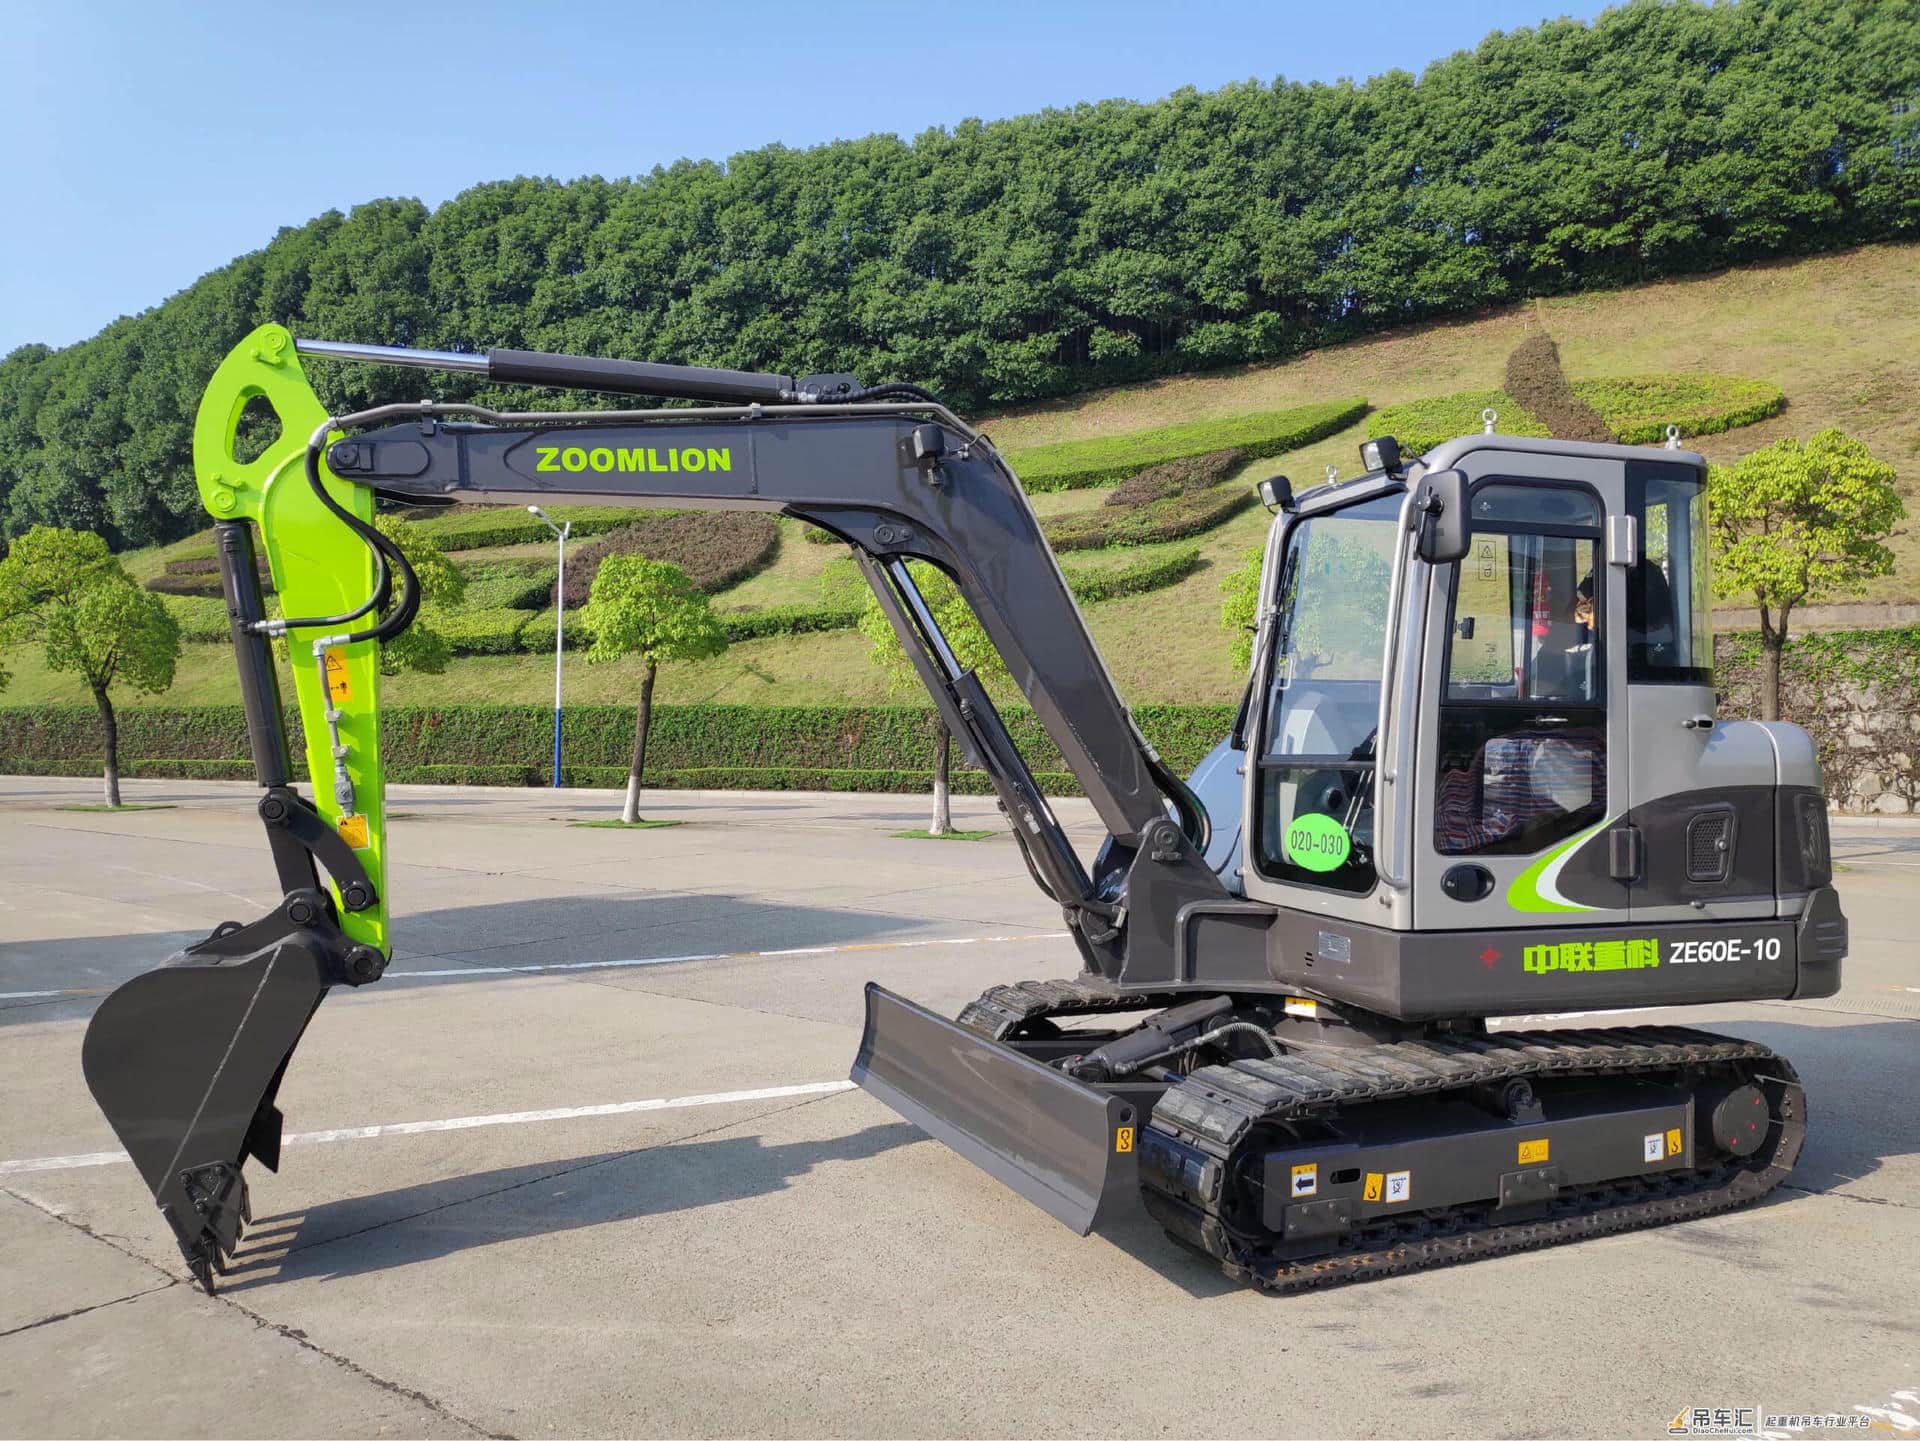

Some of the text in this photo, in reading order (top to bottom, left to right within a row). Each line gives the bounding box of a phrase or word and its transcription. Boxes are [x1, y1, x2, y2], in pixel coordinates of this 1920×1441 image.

[535, 447, 732, 472] ZOOMLION
[1291, 830, 1343, 856] 020-030
[1523, 938, 1660, 975] 中联重科
[1669, 938, 1781, 964] ZE60E-10
